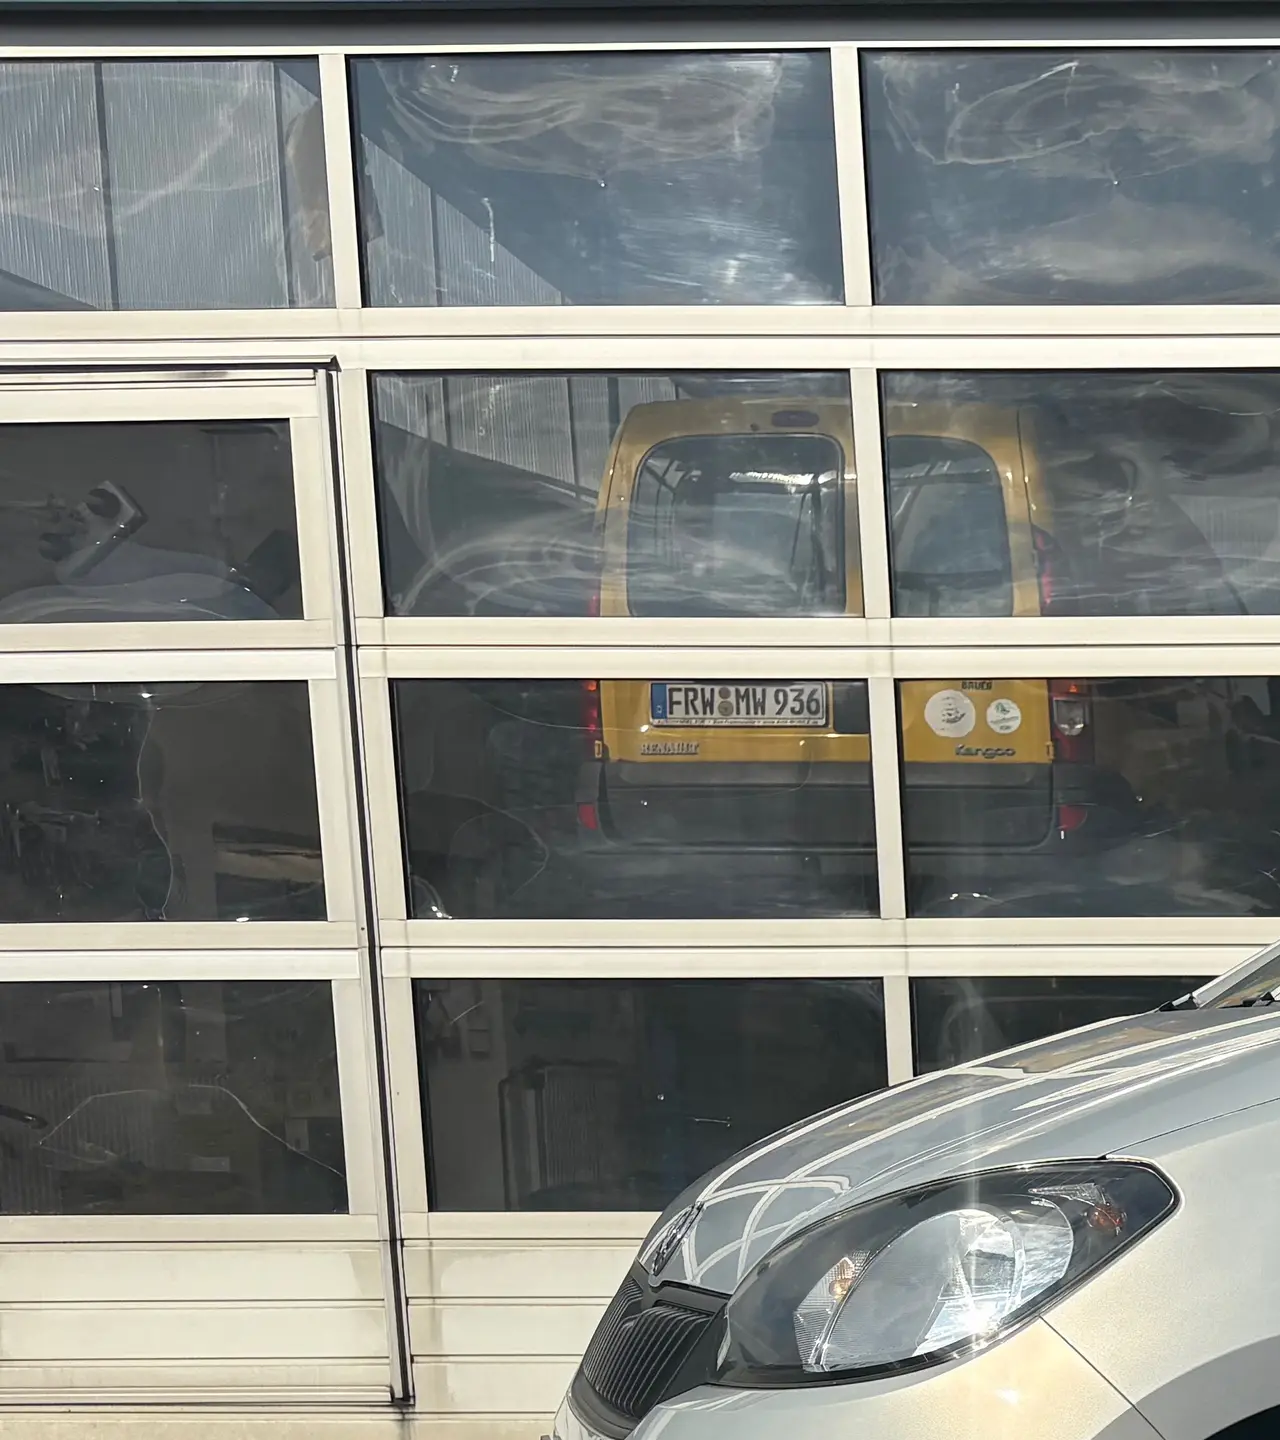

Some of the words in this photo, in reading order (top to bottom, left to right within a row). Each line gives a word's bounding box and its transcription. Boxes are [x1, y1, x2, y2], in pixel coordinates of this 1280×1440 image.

[668, 687, 715, 716] FRW
[735, 687, 767, 716] MW
[774, 687, 822, 716] 936
